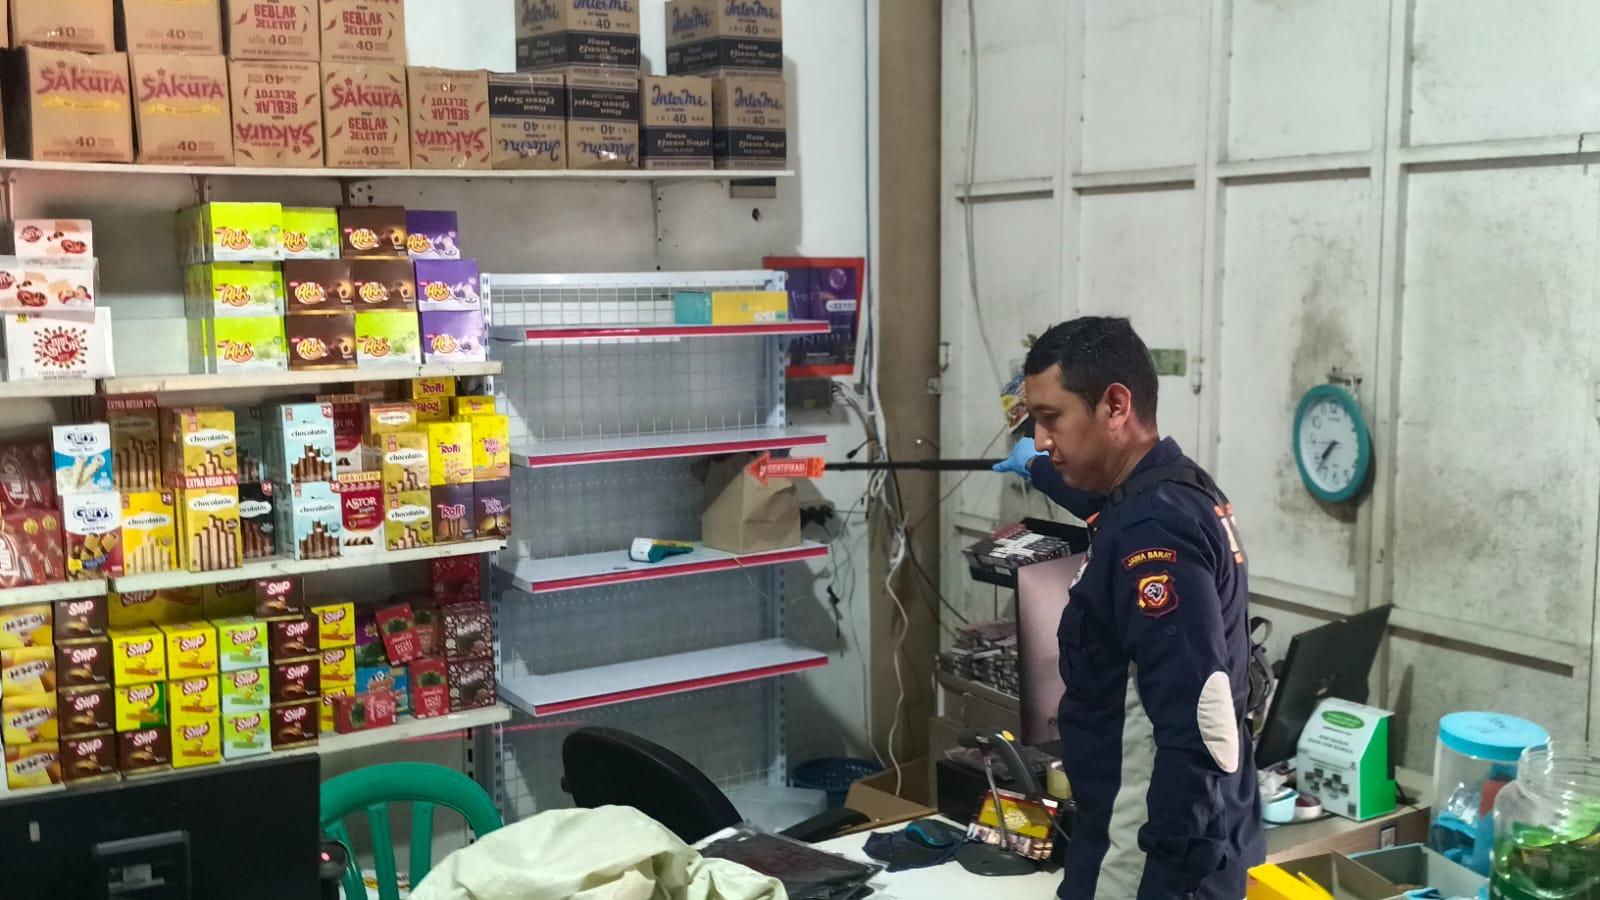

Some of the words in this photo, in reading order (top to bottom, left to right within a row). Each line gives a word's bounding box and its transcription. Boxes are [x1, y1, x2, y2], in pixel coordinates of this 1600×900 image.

[256, 18, 296, 30] JELETOT
[596, 19, 611, 29] 40
[166, 29, 186, 40] 40
[344, 24, 383, 37] JELETOT
[745, 25, 758, 35] 40
[268, 34, 287, 45] 40
[356, 40, 374, 51] 40
[265, 74, 284, 84] 40
[256, 89, 297, 101] JELETOT
[431, 97, 468, 107] JELETOT
[673, 113, 687, 124] 40
[752, 115, 765, 126] 40
[524, 121, 539, 132] 40
[600, 124, 615, 135] 40
[350, 129, 388, 142] JELETOT
[75, 136, 96, 148] 40
[177, 140, 197, 152] 40
[361, 146, 379, 156] 40
[41, 339, 79, 359] ASTOR
[346, 497, 377, 510] ASTOR
[1128, 553, 1147, 566] JAWA
[1147, 551, 1172, 559] BARAT
